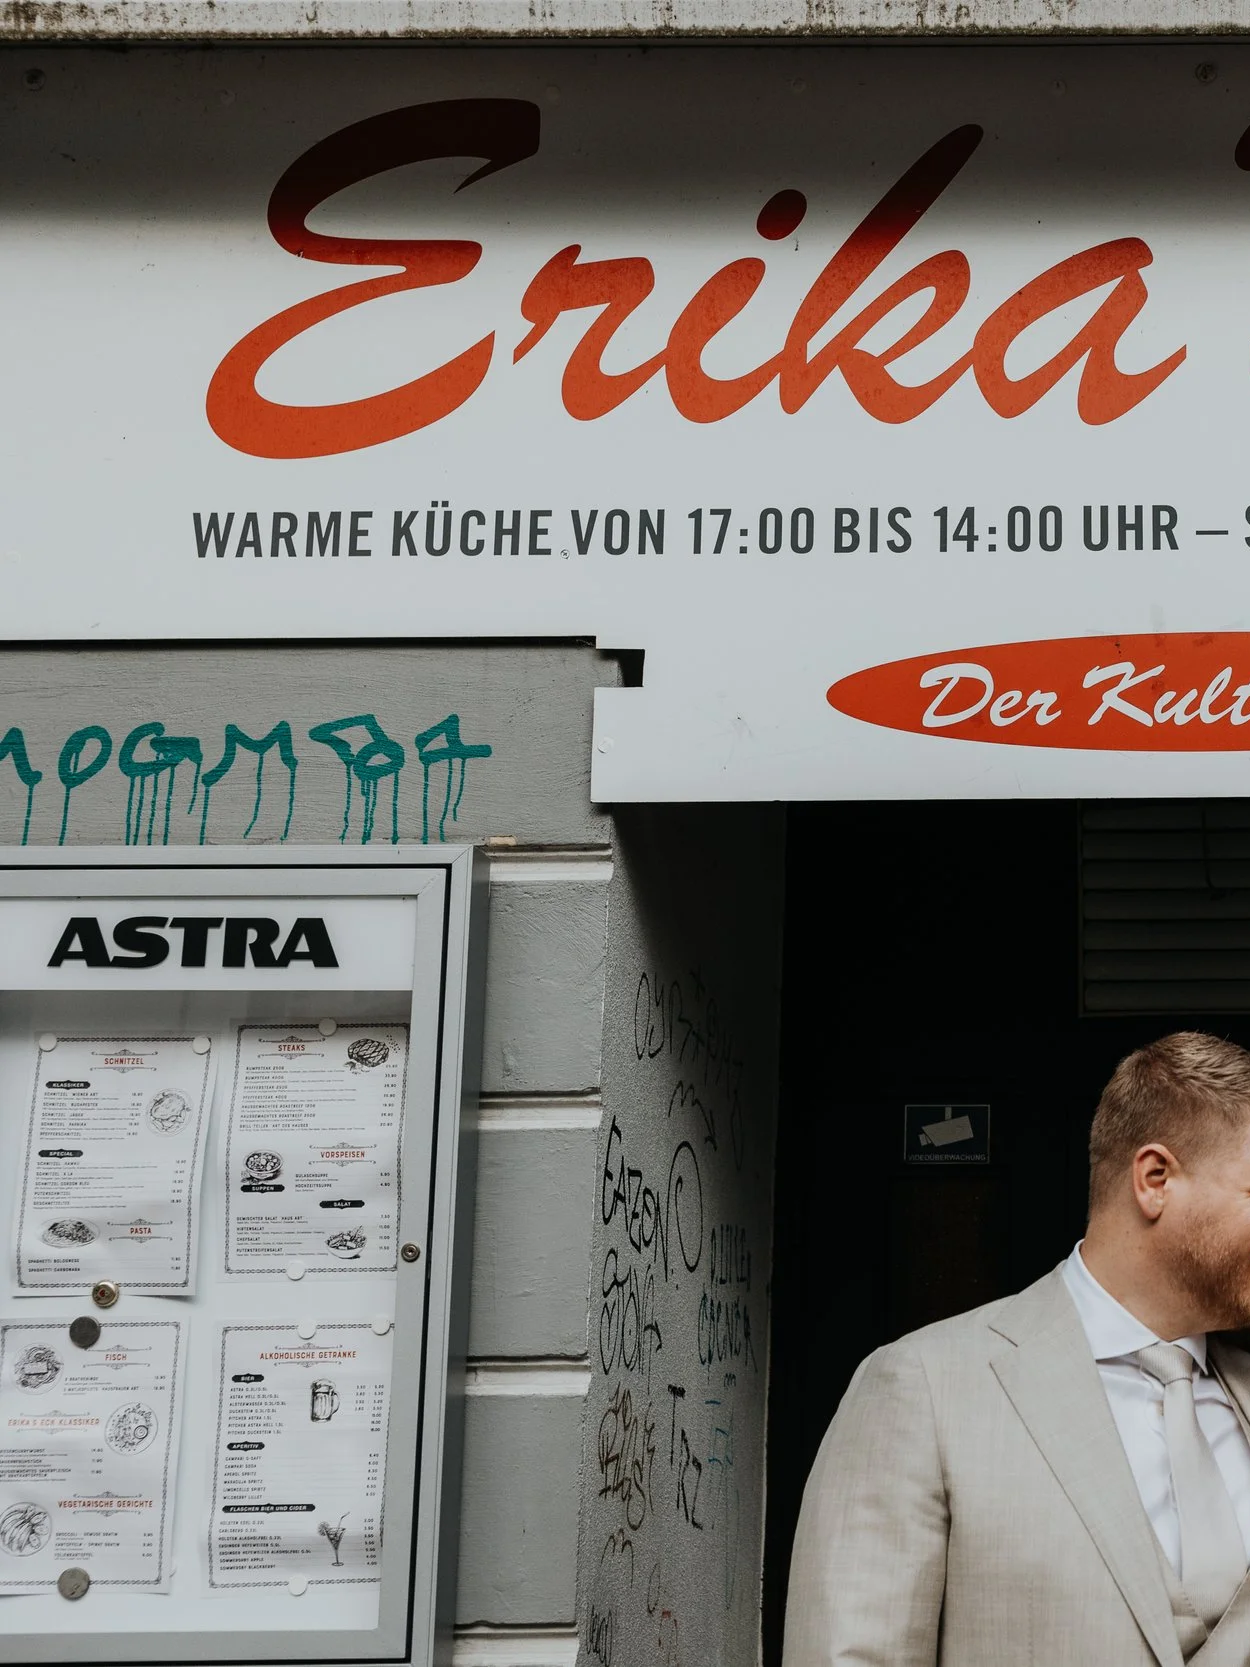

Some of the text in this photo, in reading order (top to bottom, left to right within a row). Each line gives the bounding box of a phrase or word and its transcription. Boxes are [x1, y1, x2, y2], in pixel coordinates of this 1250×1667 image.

[192, 511, 373, 558] WARME
[391, 501, 553, 557] KÜCHE
[571, 508, 666, 556] VON
[688, 507, 816, 555] 17:00
[832, 506, 912, 554] BIS
[933, 505, 1063, 553] 14:00
[1083, 504, 1180, 552] UHR
[919, 662, 1062, 730] Der
[47, 916, 340, 969] ASTRA
[278, 1044, 305, 1052] STEAKS
[104, 1057, 144, 1065] SCHNITZEL
[320, 1151, 366, 1159] VORSPEISEN
[130, 1227, 152, 1235] PASTA
[105, 1353, 127, 1361] FISCH
[259, 1351, 316, 1360] ALKOHOLISCHE
[58, 1500, 153, 1508] VEGETARISCHE GERICHTE
